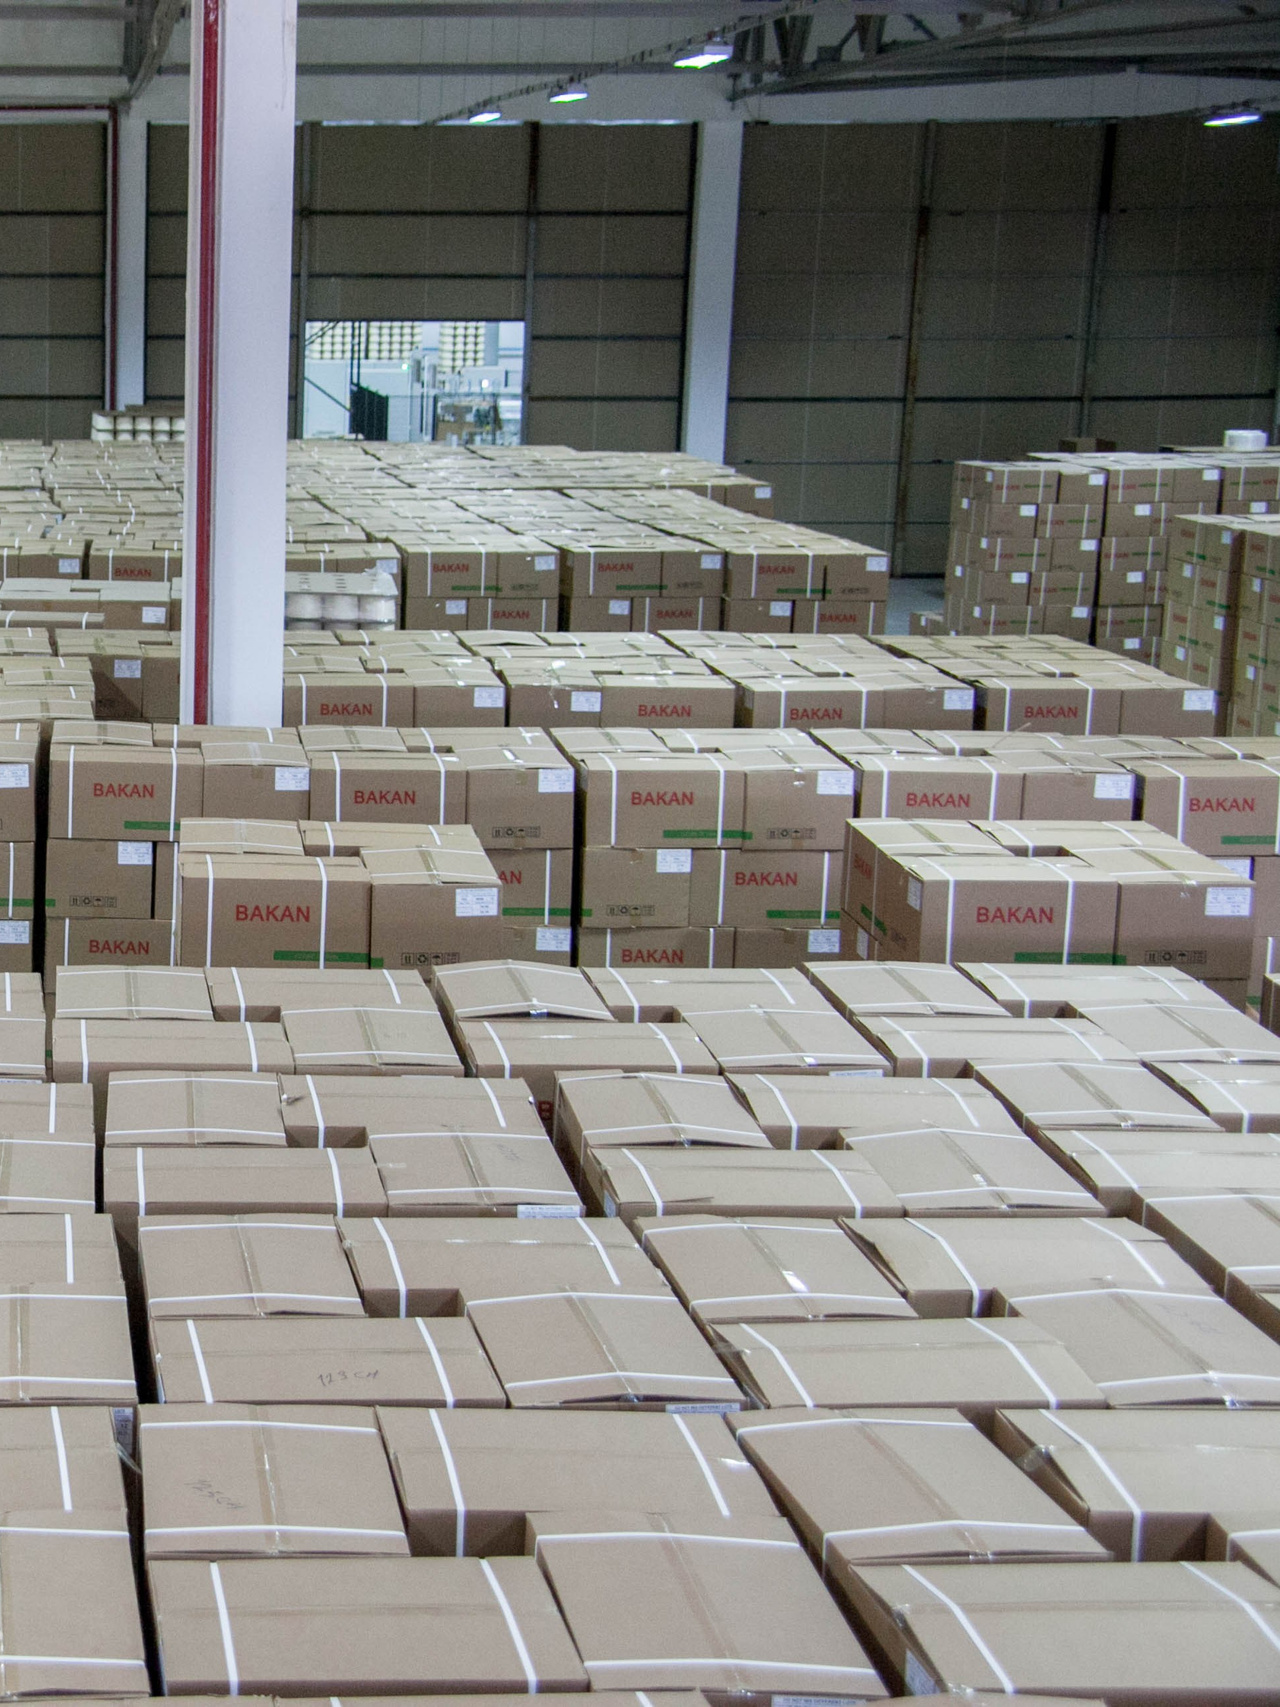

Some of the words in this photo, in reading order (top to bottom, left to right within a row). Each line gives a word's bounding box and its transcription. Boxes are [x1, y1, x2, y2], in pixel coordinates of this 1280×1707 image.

[115, 568, 152, 577] BAKAN
[432, 564, 469, 573] BAKAN
[597, 563, 634, 572] BAKAN
[757, 565, 795, 575] BAKAN
[492, 610, 530, 619] BAKAN
[656, 610, 693, 620] BAKAN
[819, 613, 857, 623] BAKAN
[320, 704, 373, 716] BAKAN
[638, 705, 691, 717] BAKAN
[789, 708, 842, 720] BAKAN
[1025, 706, 1078, 718] BAKAN
[93, 783, 155, 798] BAKAN
[354, 791, 415, 805] BAKAN
[631, 792, 694, 805] BAKAN
[906, 793, 970, 807] BAKAN
[1188, 798, 1255, 813] BAKAN
[735, 873, 797, 885] BAKAN
[235, 904, 310, 922] BAKAN
[976, 907, 1053, 923] BAKAN
[89, 940, 150, 954] BAKAN
[622, 949, 683, 964] BAKAN
